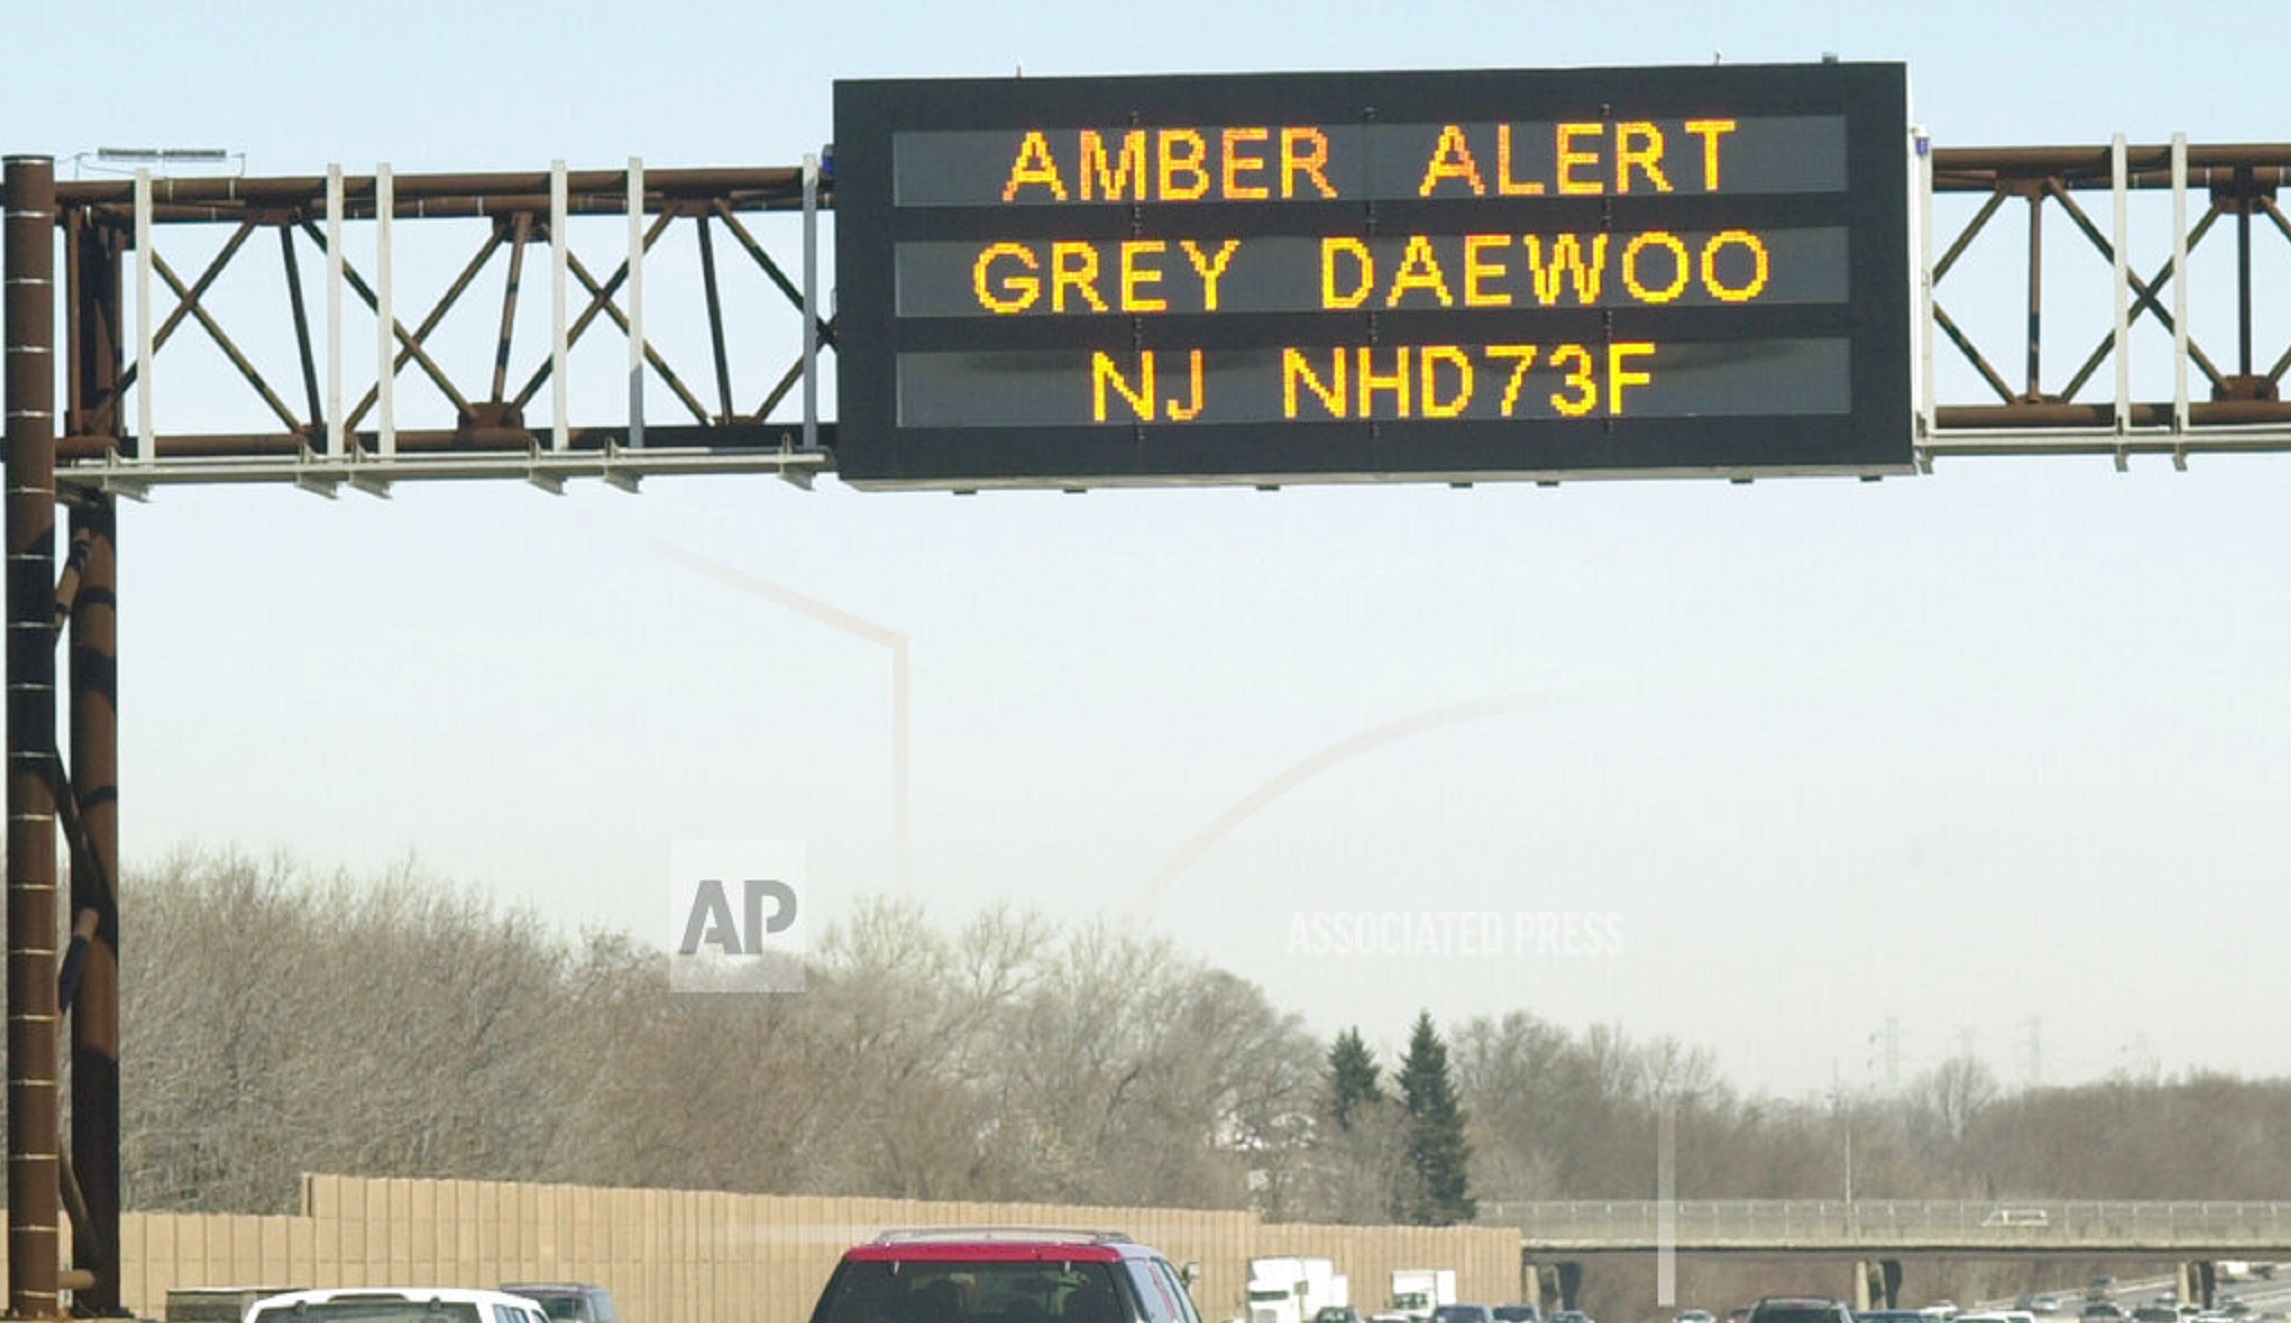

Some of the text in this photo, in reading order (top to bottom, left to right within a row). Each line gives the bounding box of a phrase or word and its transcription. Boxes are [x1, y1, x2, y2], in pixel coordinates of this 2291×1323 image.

[1003, 118, 1737, 202] AMBER ALERT
[972, 229, 1770, 314] GREY DAEWOO
[1091, 341, 1656, 424] NJ NHD73F
